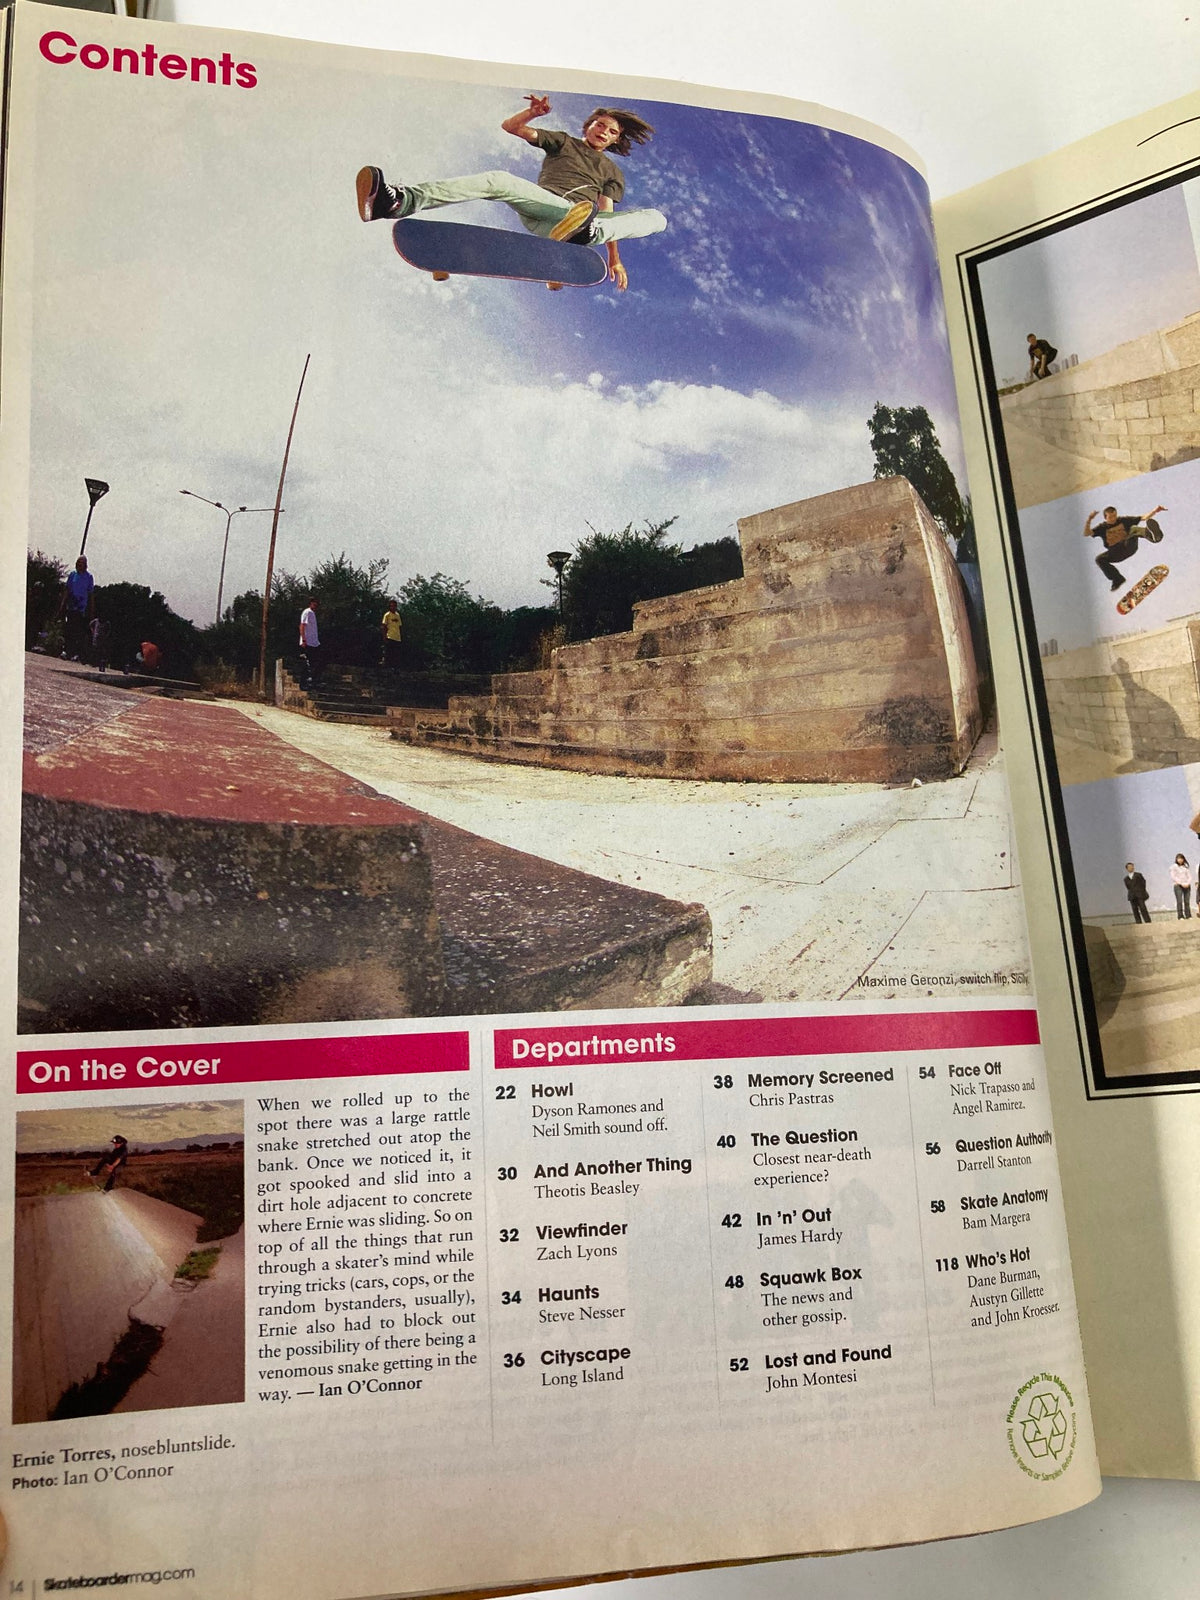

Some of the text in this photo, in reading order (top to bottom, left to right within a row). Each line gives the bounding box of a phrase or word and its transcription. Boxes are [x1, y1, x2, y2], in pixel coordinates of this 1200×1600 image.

[39, 31, 257, 88] Contents
[857, 974, 907, 988] Maxime
[910, 974, 957, 987] Geronzi,
[959, 973, 992, 985] switch
[512, 1032, 676, 1062] Departments
[29, 1057, 221, 1083] On the Cover
[713, 1067, 894, 1089] 38 Memory Screened
[919, 1061, 1002, 1080] 54 Face Off
[495, 1082, 573, 1100] 22 Howl
[950, 1078, 1035, 1097] Nick Trapasso and
[532, 1098, 664, 1121] Dyson Ramones and
[749, 1092, 834, 1107] Chris Pastras
[952, 1098, 1025, 1117] Angel Ramirez.
[532, 1117, 668, 1138] Neil Smith sound off.
[716, 1128, 858, 1149] 40 The Question
[257, 1127, 471, 1153] snake stretched out atop the
[925, 1130, 1052, 1156] 56 Question Authority
[753, 1146, 872, 1166] Closest near-death
[957, 1155, 1032, 1172] Darrell Stanton
[497, 1157, 692, 1181] 30 And Another Thing
[754, 1169, 829, 1189] experience?
[534, 1180, 640, 1199] Theotis Beasley
[257, 1191, 472, 1216] dirt hole adjacent to concrete
[930, 1189, 1048, 1214] 58 Skate Anatomy
[257, 1209, 473, 1233] where Ernie was sliding. So on
[721, 1213, 742, 1228] 42
[756, 1212, 772, 1227] In
[801, 1207, 832, 1223] Out
[962, 1213, 1031, 1230] Bam Margera
[499, 1221, 628, 1243] 32 Viewfinder
[757, 1227, 843, 1250] James Hardy
[258, 1248, 474, 1276] through a skater's mind while
[537, 1245, 618, 1261] Zach Lyons
[935, 1246, 1030, 1272] 118 Who's Hot
[258, 1280, 302, 1298] trying
[305, 1276, 346, 1293] tricks
[350, 1276, 389, 1292] (cars,
[392, 1275, 430, 1290] cops,
[453, 1268, 475, 1283] the
[724, 1267, 863, 1289] 48 Squawk Box
[967, 1269, 1041, 1288] Dane Burman,
[258, 1289, 475, 1316] random bystanders, usually),
[501, 1284, 600, 1305] 34 Haunts
[760, 1286, 853, 1307] The news and
[969, 1284, 1045, 1308] Austyn Gillette
[539, 1306, 626, 1323] Steve Nesser
[762, 1308, 847, 1327] other gossip.
[970, 1302, 1060, 1328] and John Kroesser.
[258, 1350, 477, 1380] venomous snake getting in the
[503, 1347, 631, 1368] 36 Cityscape
[729, 1344, 892, 1372] 52 Lost and Found
[541, 1366, 624, 1388] Long Island
[765, 1369, 857, 1393] John Montesi
[258, 1378, 423, 1404] way. Ian O'Connor
[1006, 1396, 1020, 1423] Please
[1017, 1375, 1040, 1397] Recycle
[1040, 1372, 1053, 1382] This
[12, 1434, 235, 1468] Ernie Torres, nosebluntslide.
[12, 1465, 174, 1490] Photo: Ian O'Connor
